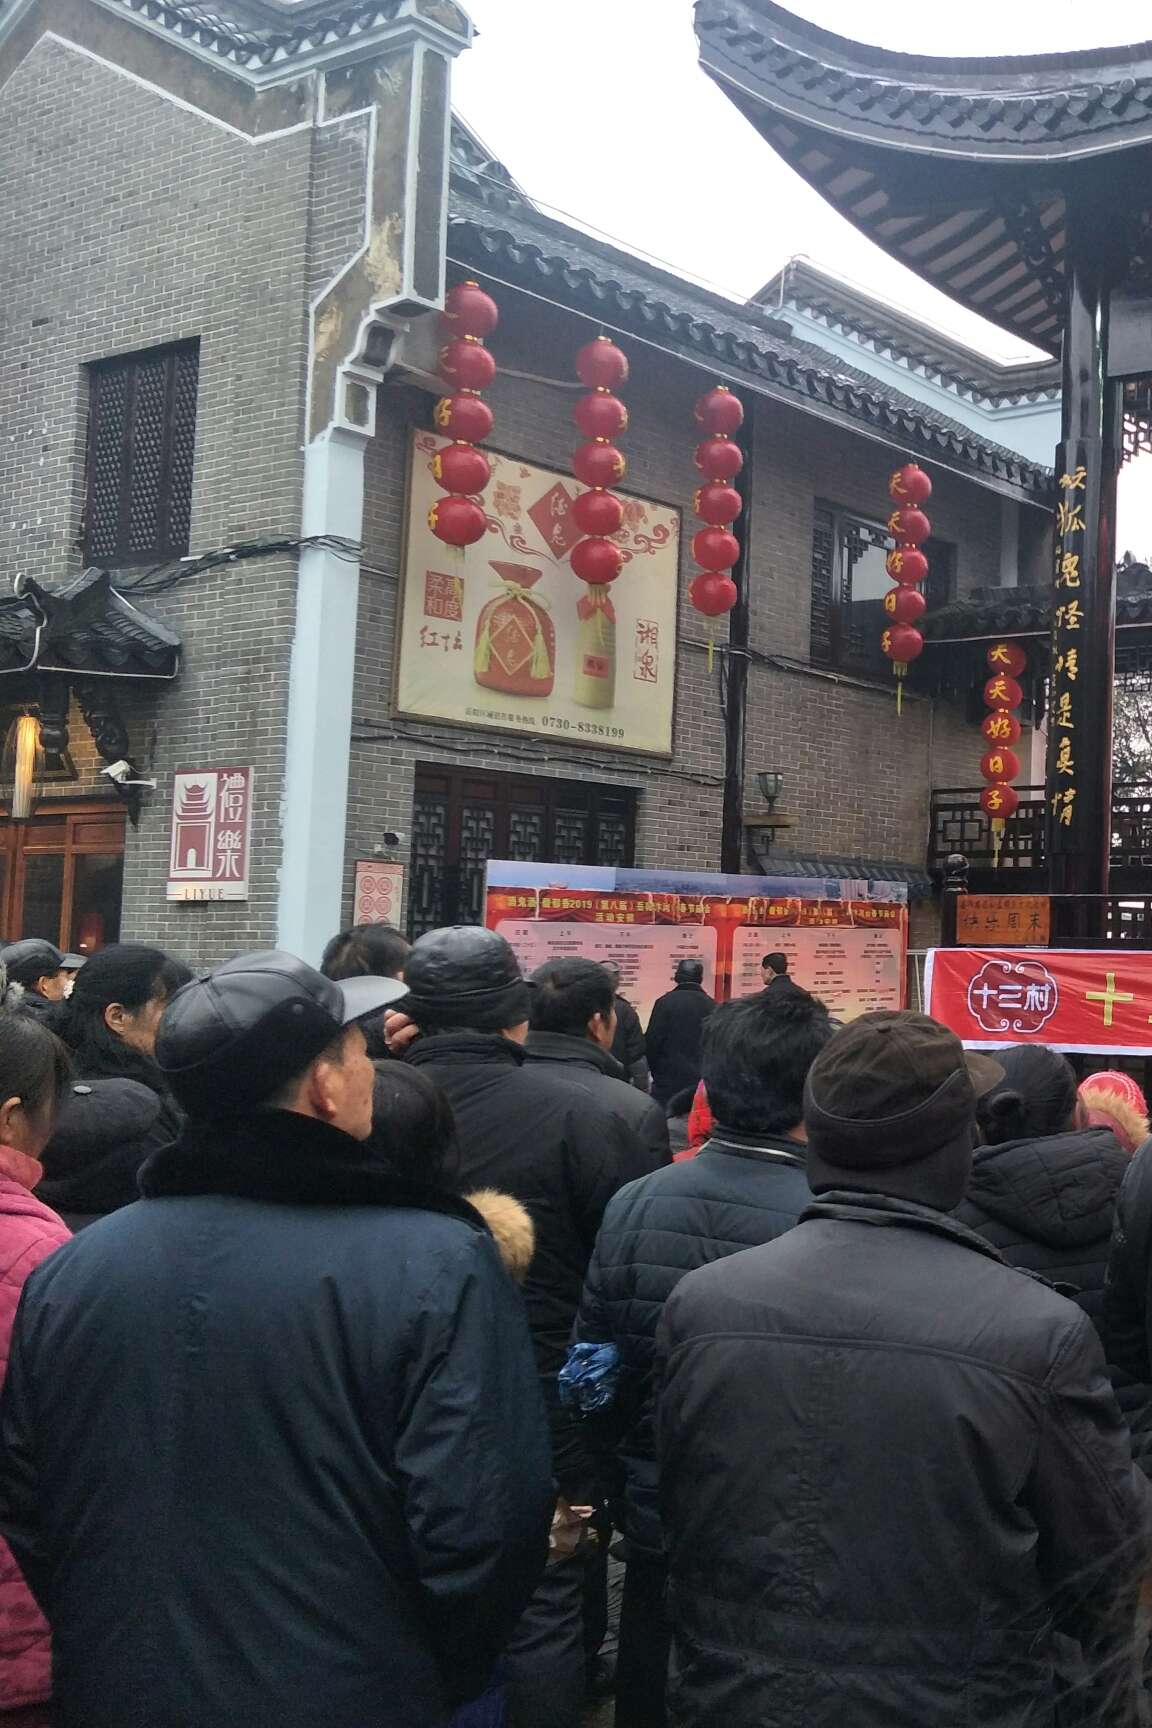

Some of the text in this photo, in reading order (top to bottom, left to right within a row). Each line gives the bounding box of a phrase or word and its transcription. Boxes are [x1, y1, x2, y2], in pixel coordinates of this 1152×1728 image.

[541, 715, 625, 739] 0730-8338199
[185, 888, 225, 900] LIYUE
[972, 982, 1052, 1012] 十三村
